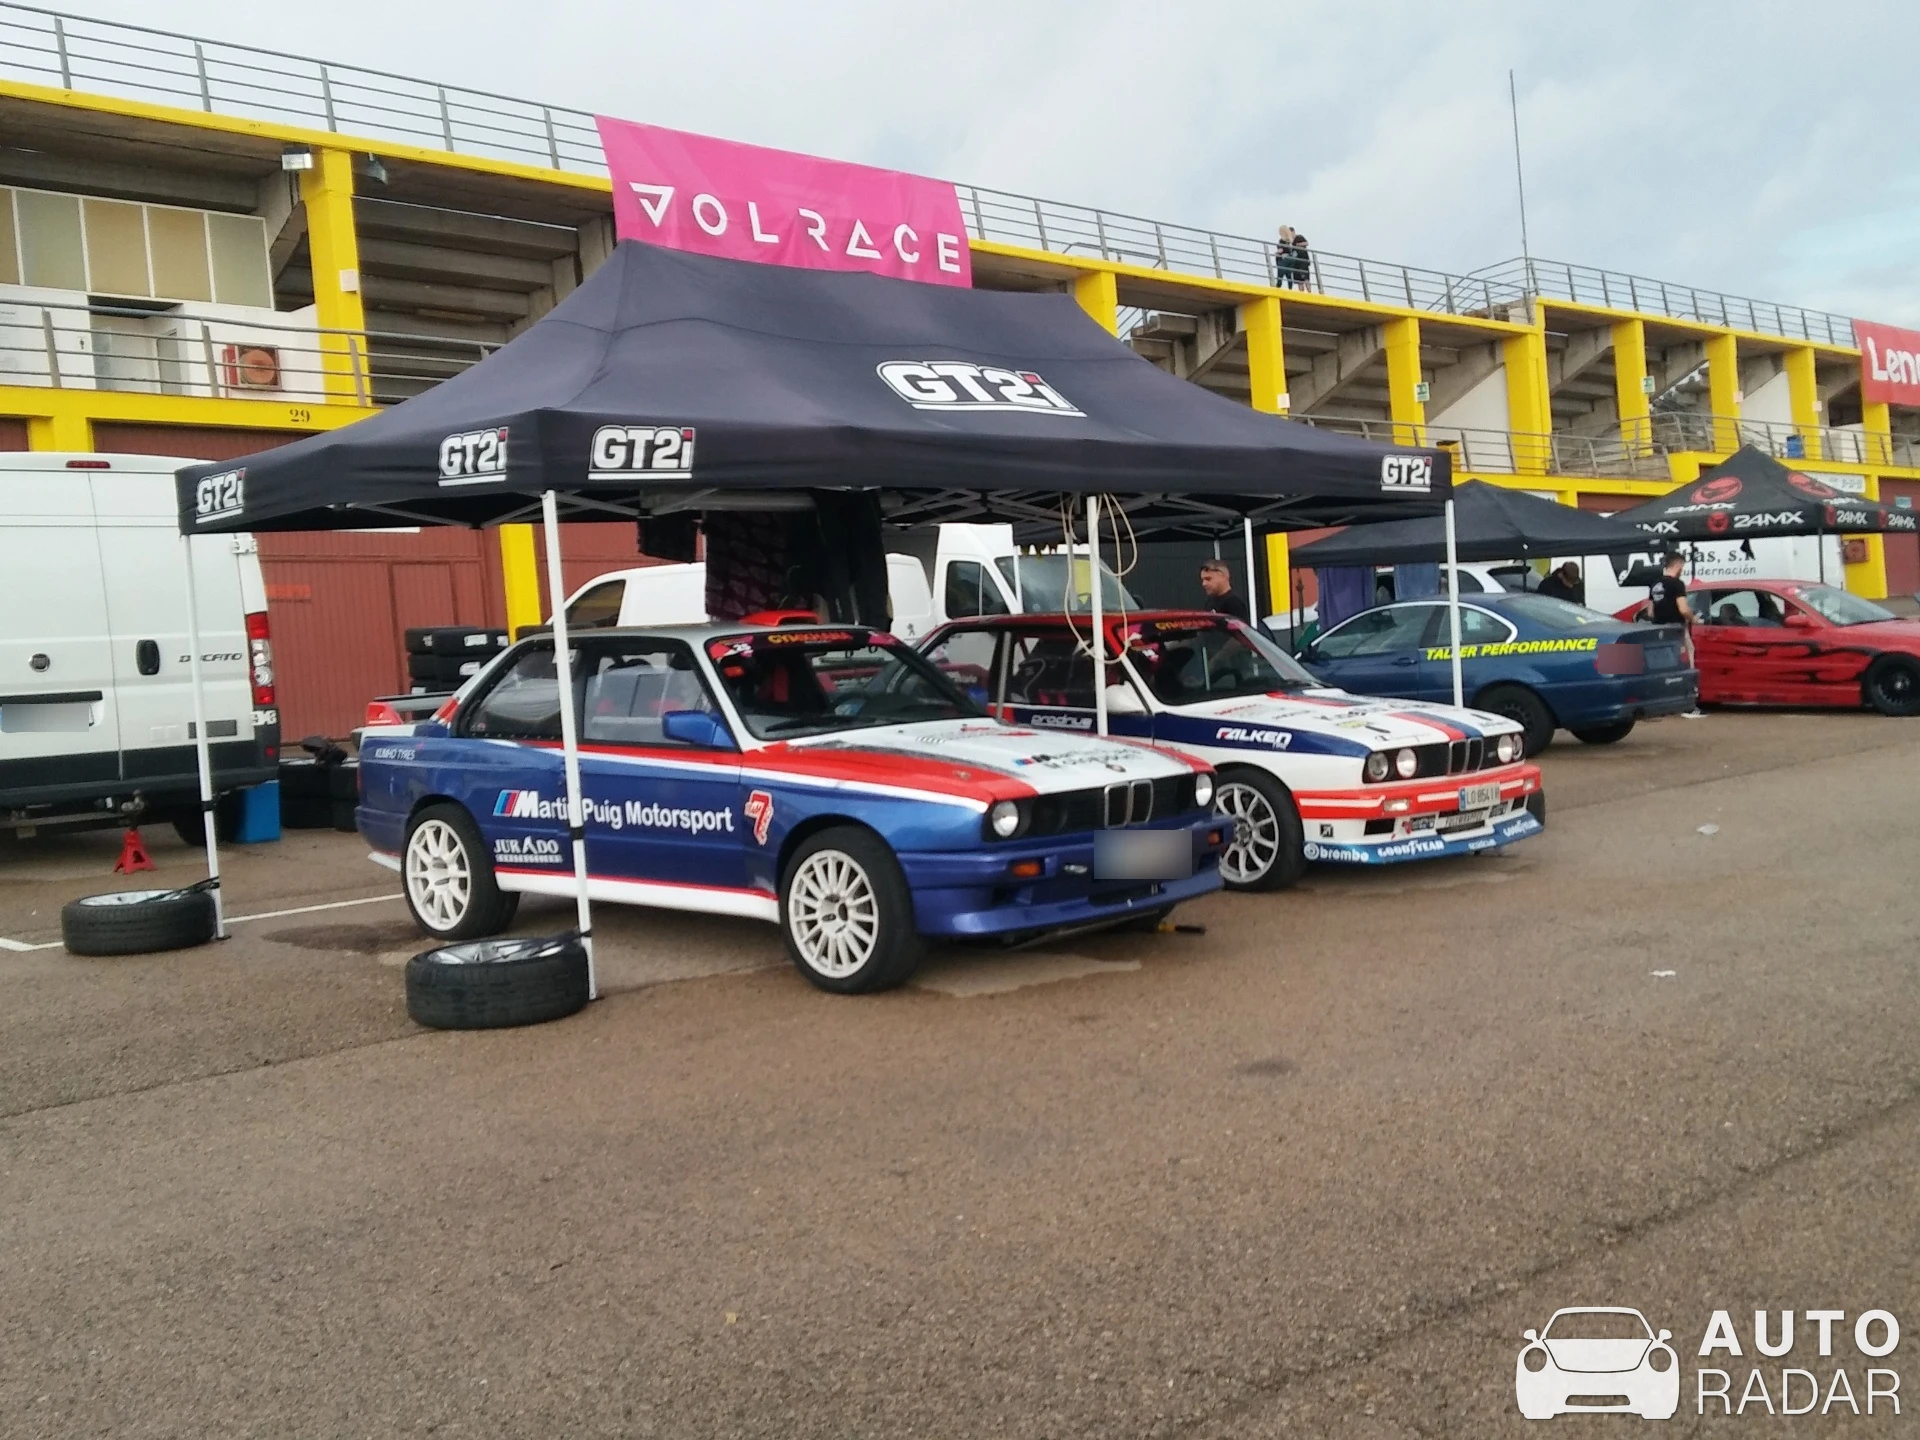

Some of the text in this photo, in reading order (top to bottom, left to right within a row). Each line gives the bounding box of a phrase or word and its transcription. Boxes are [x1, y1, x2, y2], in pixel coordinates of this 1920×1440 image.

[628, 181, 961, 275] VOLRACE
[880, 362, 1073, 410] GT2i
[289, 408, 310, 422] 29
[439, 428, 508, 479] GT2i
[592, 427, 695, 473] GT2i
[1382, 455, 1432, 486] GT2i
[196, 469, 246, 515] GT2i
[1733, 510, 1804, 529] 24MX
[1836, 509, 1868, 525] 24MX
[1888, 513, 1917, 530] 24MX
[179, 652, 242, 662] DCATO
[1426, 638, 1598, 661] TALER PERFORMANCE
[1215, 726, 1293, 746] FALKEN
[512, 790, 568, 820] Marti
[582, 798, 623, 830] Puig
[625, 800, 735, 835] Motorsport
[494, 836, 560, 854] JURADO
[1319, 845, 1369, 861] brembo
[1377, 840, 1445, 857] GOODYEAR
